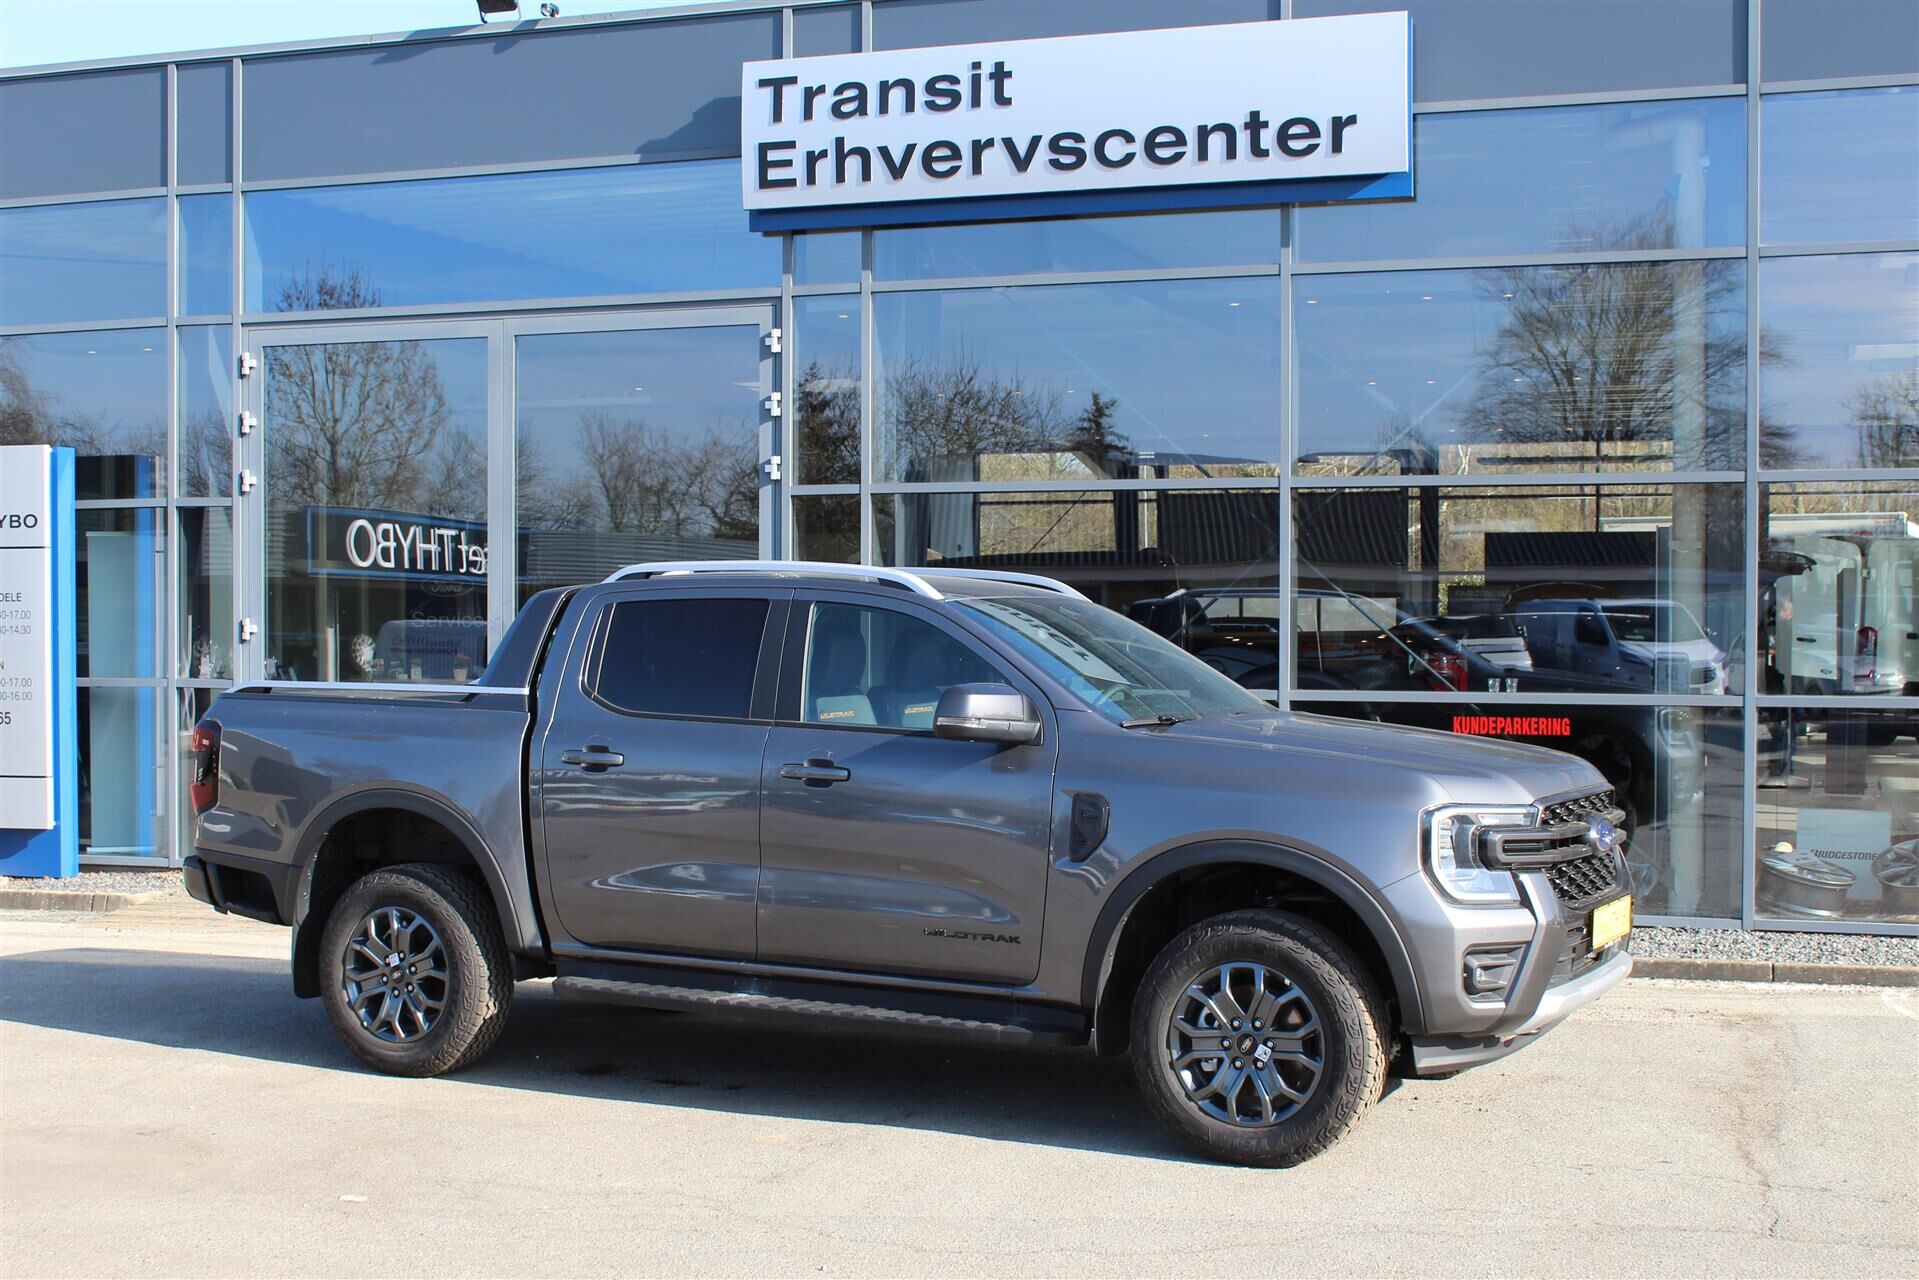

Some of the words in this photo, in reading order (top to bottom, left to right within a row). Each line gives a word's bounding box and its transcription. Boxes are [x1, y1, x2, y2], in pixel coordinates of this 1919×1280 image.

[758, 61, 1012, 123] Transit
[758, 110, 1357, 189] Erhvervscenter
[412, 611, 484, 628] Service
[1453, 715, 1571, 736] KUNDEPARKERING
[923, 927, 1021, 944] WILDTRAK
